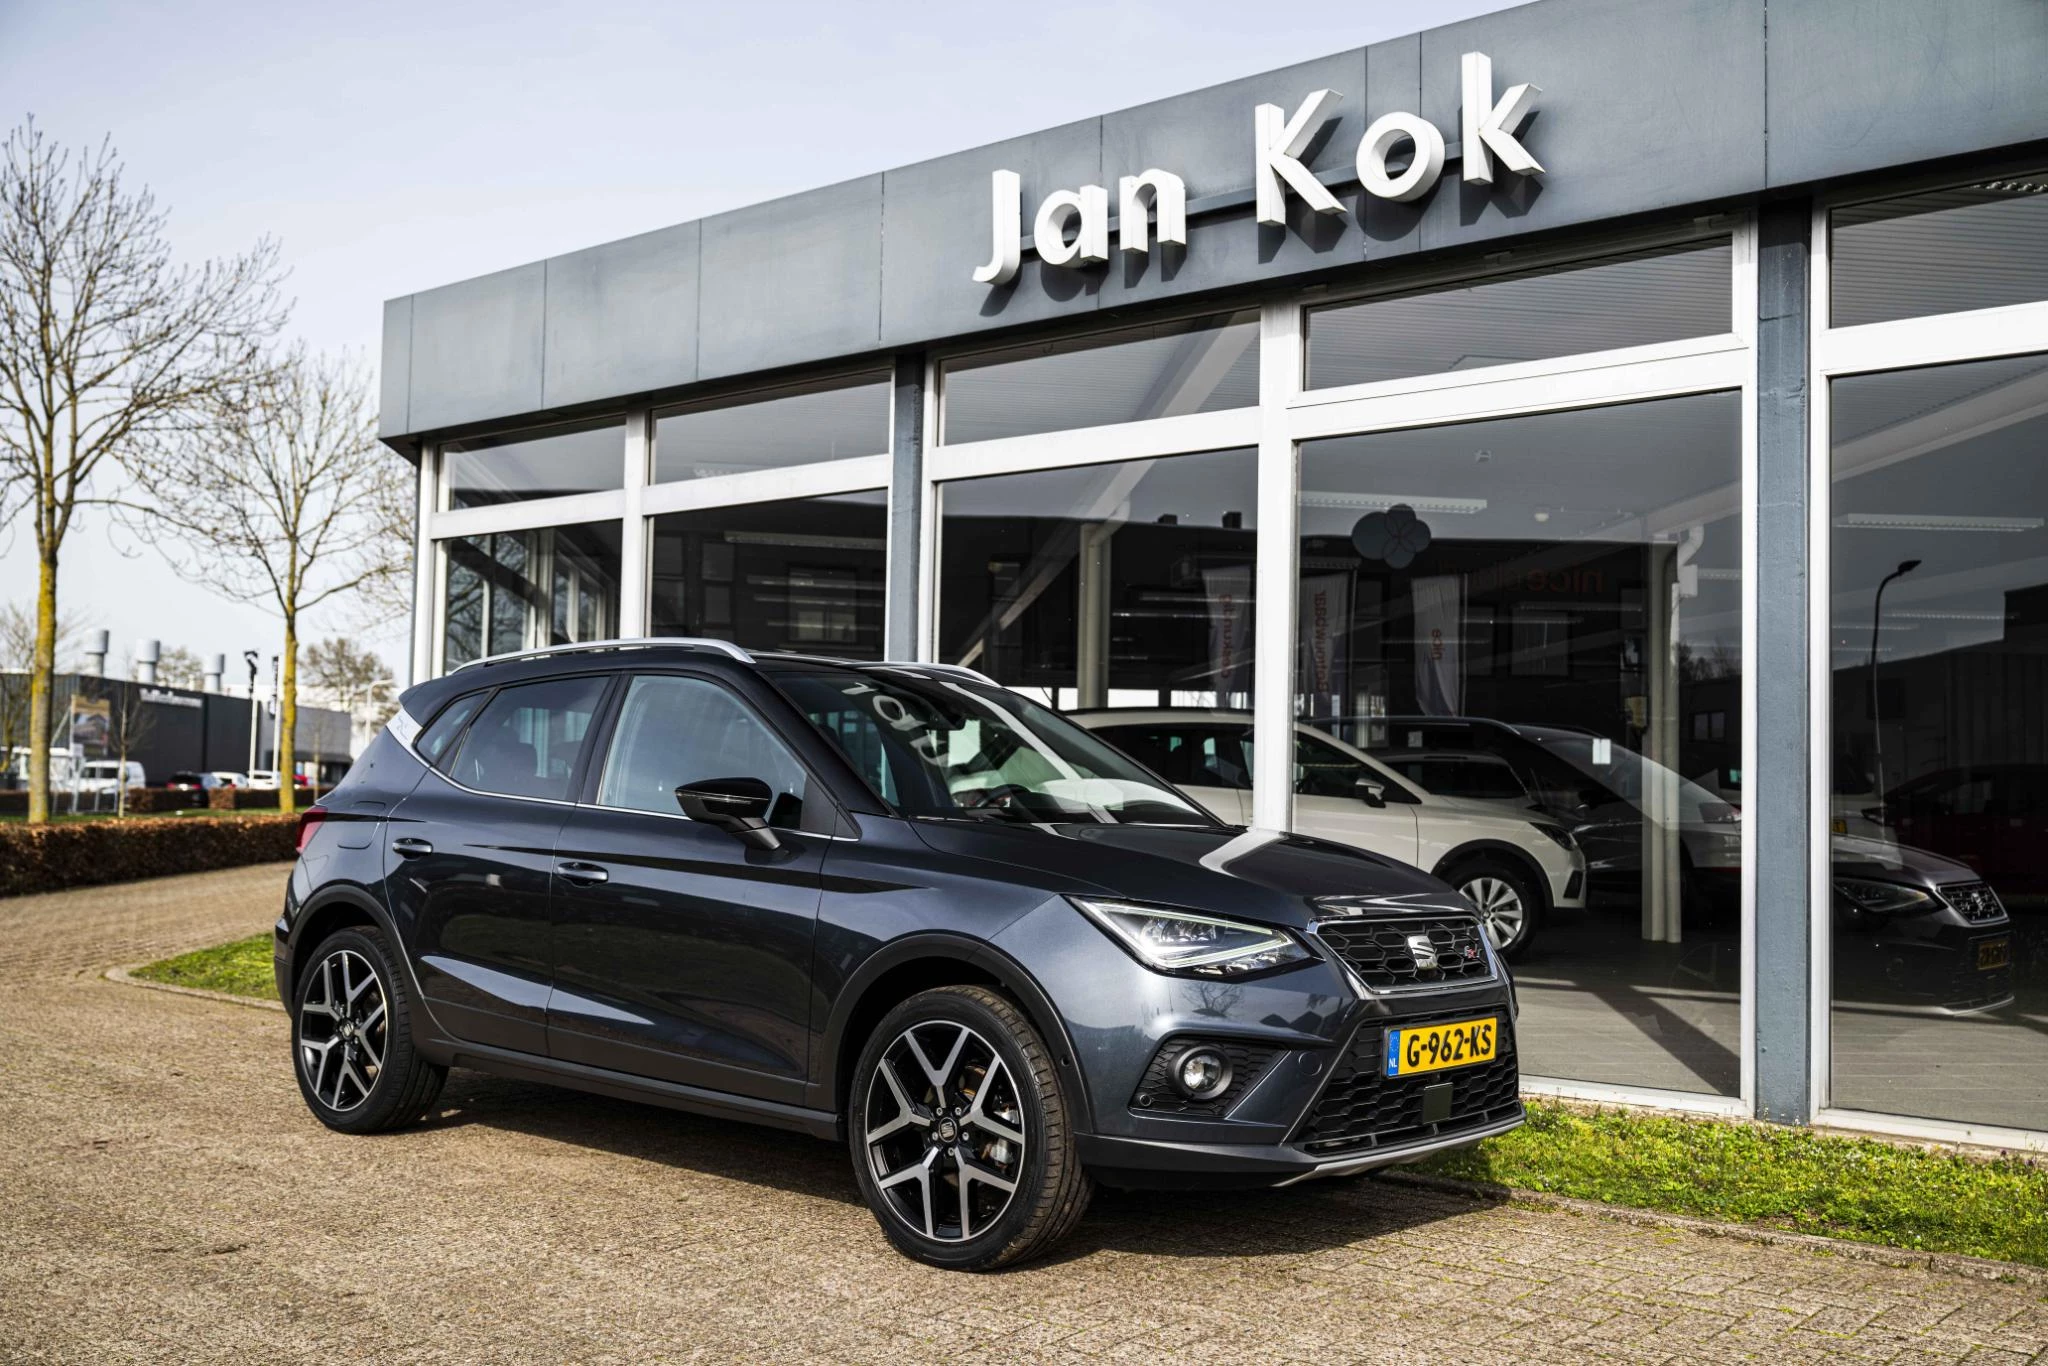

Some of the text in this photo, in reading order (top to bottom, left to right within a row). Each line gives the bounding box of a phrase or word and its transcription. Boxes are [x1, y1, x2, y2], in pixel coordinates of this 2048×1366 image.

[972, 51, 1546, 285] Jan Kok
[1388, 1058, 1398, 1068] NL
[1406, 1024, 1492, 1067] G-962-KS
